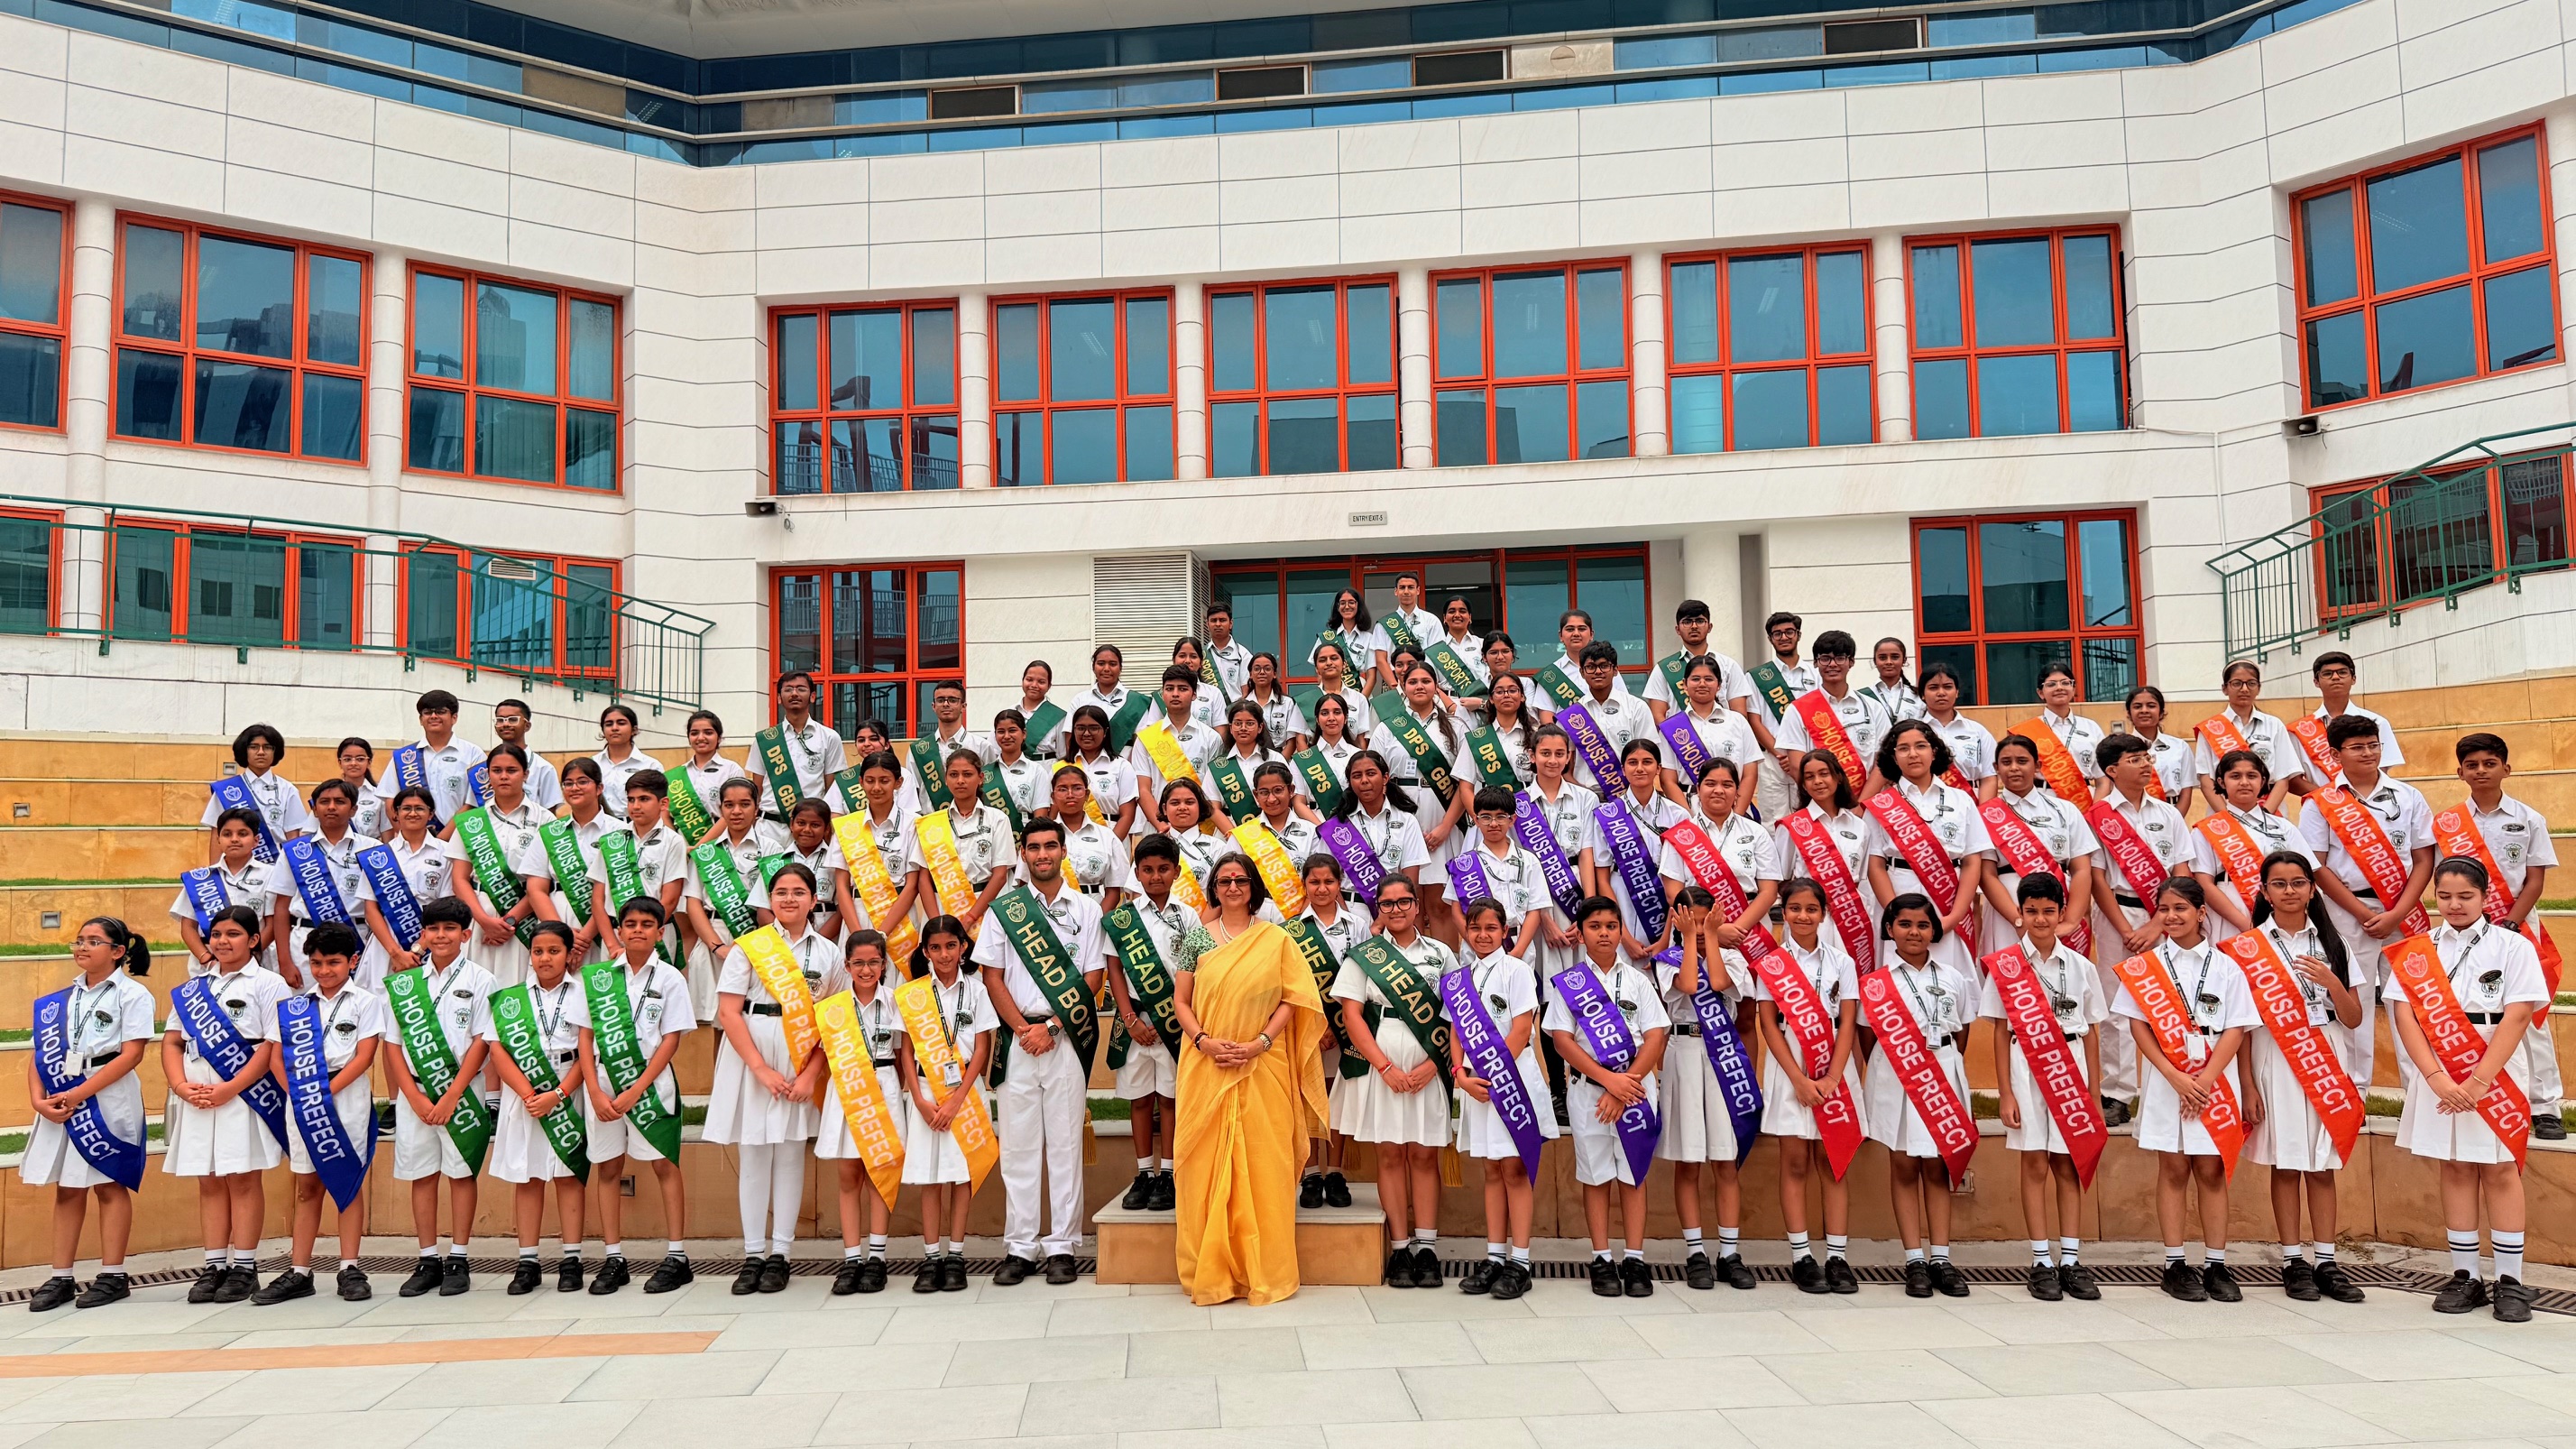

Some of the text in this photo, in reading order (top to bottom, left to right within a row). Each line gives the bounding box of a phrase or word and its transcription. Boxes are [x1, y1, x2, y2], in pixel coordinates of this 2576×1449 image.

[1394, 628, 1412, 646] VIC
[767, 745, 787, 776] DPS
[1403, 727, 1455, 800] DPS GBN
[1478, 743, 1501, 773] DPS
[1576, 725, 1610, 766] HOUSE
[1818, 726, 1849, 765] HOUSE
[2044, 751, 2080, 794] HOUSE
[2308, 734, 2338, 772] HOUSE
[923, 761, 942, 792] DPS
[1220, 772, 1245, 803] DPS
[1307, 763, 1331, 794] DPS
[673, 789, 702, 829] HOUSE
[2333, 803, 2374, 847] HOUSE
[470, 832, 498, 872] HOUSE
[484, 865, 520, 911] PREFEC
[553, 835, 580, 874] HOUSE
[850, 838, 879, 884] HOUSE
[931, 844, 961, 891] HOUSE
[1256, 835, 1289, 886] HOUSE
[1343, 843, 1380, 885] HOUSE
[1521, 817, 1576, 907] HOUSE PREFECT
[1607, 817, 1640, 859] HOUSE
[1627, 856, 1661, 913] PREFECT
[1882, 805, 1922, 846] HOUSE
[1908, 839, 1954, 895] PREFECT
[1998, 821, 2036, 862] HOUSE
[2115, 838, 2149, 881] HOUSE
[2219, 834, 2259, 876] HOUSE
[195, 880, 225, 915] HOUSE
[299, 859, 327, 899] HOUSE
[375, 867, 408, 908] HOUSE
[609, 854, 634, 891] HOUSE
[704, 860, 732, 899] HOUSE
[1686, 843, 1721, 884] HOUSE
[1710, 878, 1743, 923] PREFE
[1803, 835, 1839, 884] HOUSE
[1825, 876, 1864, 938] PREFECT
[760, 953, 805, 1018] HOUSE
[1016, 921, 1093, 1037] HEAD BOY
[1121, 929, 1164, 995] HEAD
[1155, 996, 1183, 1045] BO
[1379, 960, 1434, 1024] HEAD
[1774, 974, 1825, 1041] HOUSE
[2134, 974, 2185, 1043] HOUSE
[184, 991, 230, 1049] HOUSE
[399, 994, 439, 1059] HOUSE
[596, 992, 629, 1057] HOUSE
[914, 1010, 955, 1076] HOUSE
[1574, 988, 1624, 1049] HOUSE
[1692, 970, 1757, 1117] OUSE PREFECT
[2245, 957, 2352, 1115] HOUSE PREFECT
[2414, 977, 2469, 1051] HOUSE
[41, 1023, 74, 1088] HOUSE
[505, 1018, 545, 1083] HOUSE
[1450, 988, 1532, 1131] HOUSE PREFECT
[1873, 1000, 1972, 1154] HOUSE PREFECT
[2006, 979, 2096, 1138] HOUSE PREFECT
[289, 1016, 345, 1163] HOUSE PREFECT
[832, 1028, 897, 1170] HOUSE PREFECT
